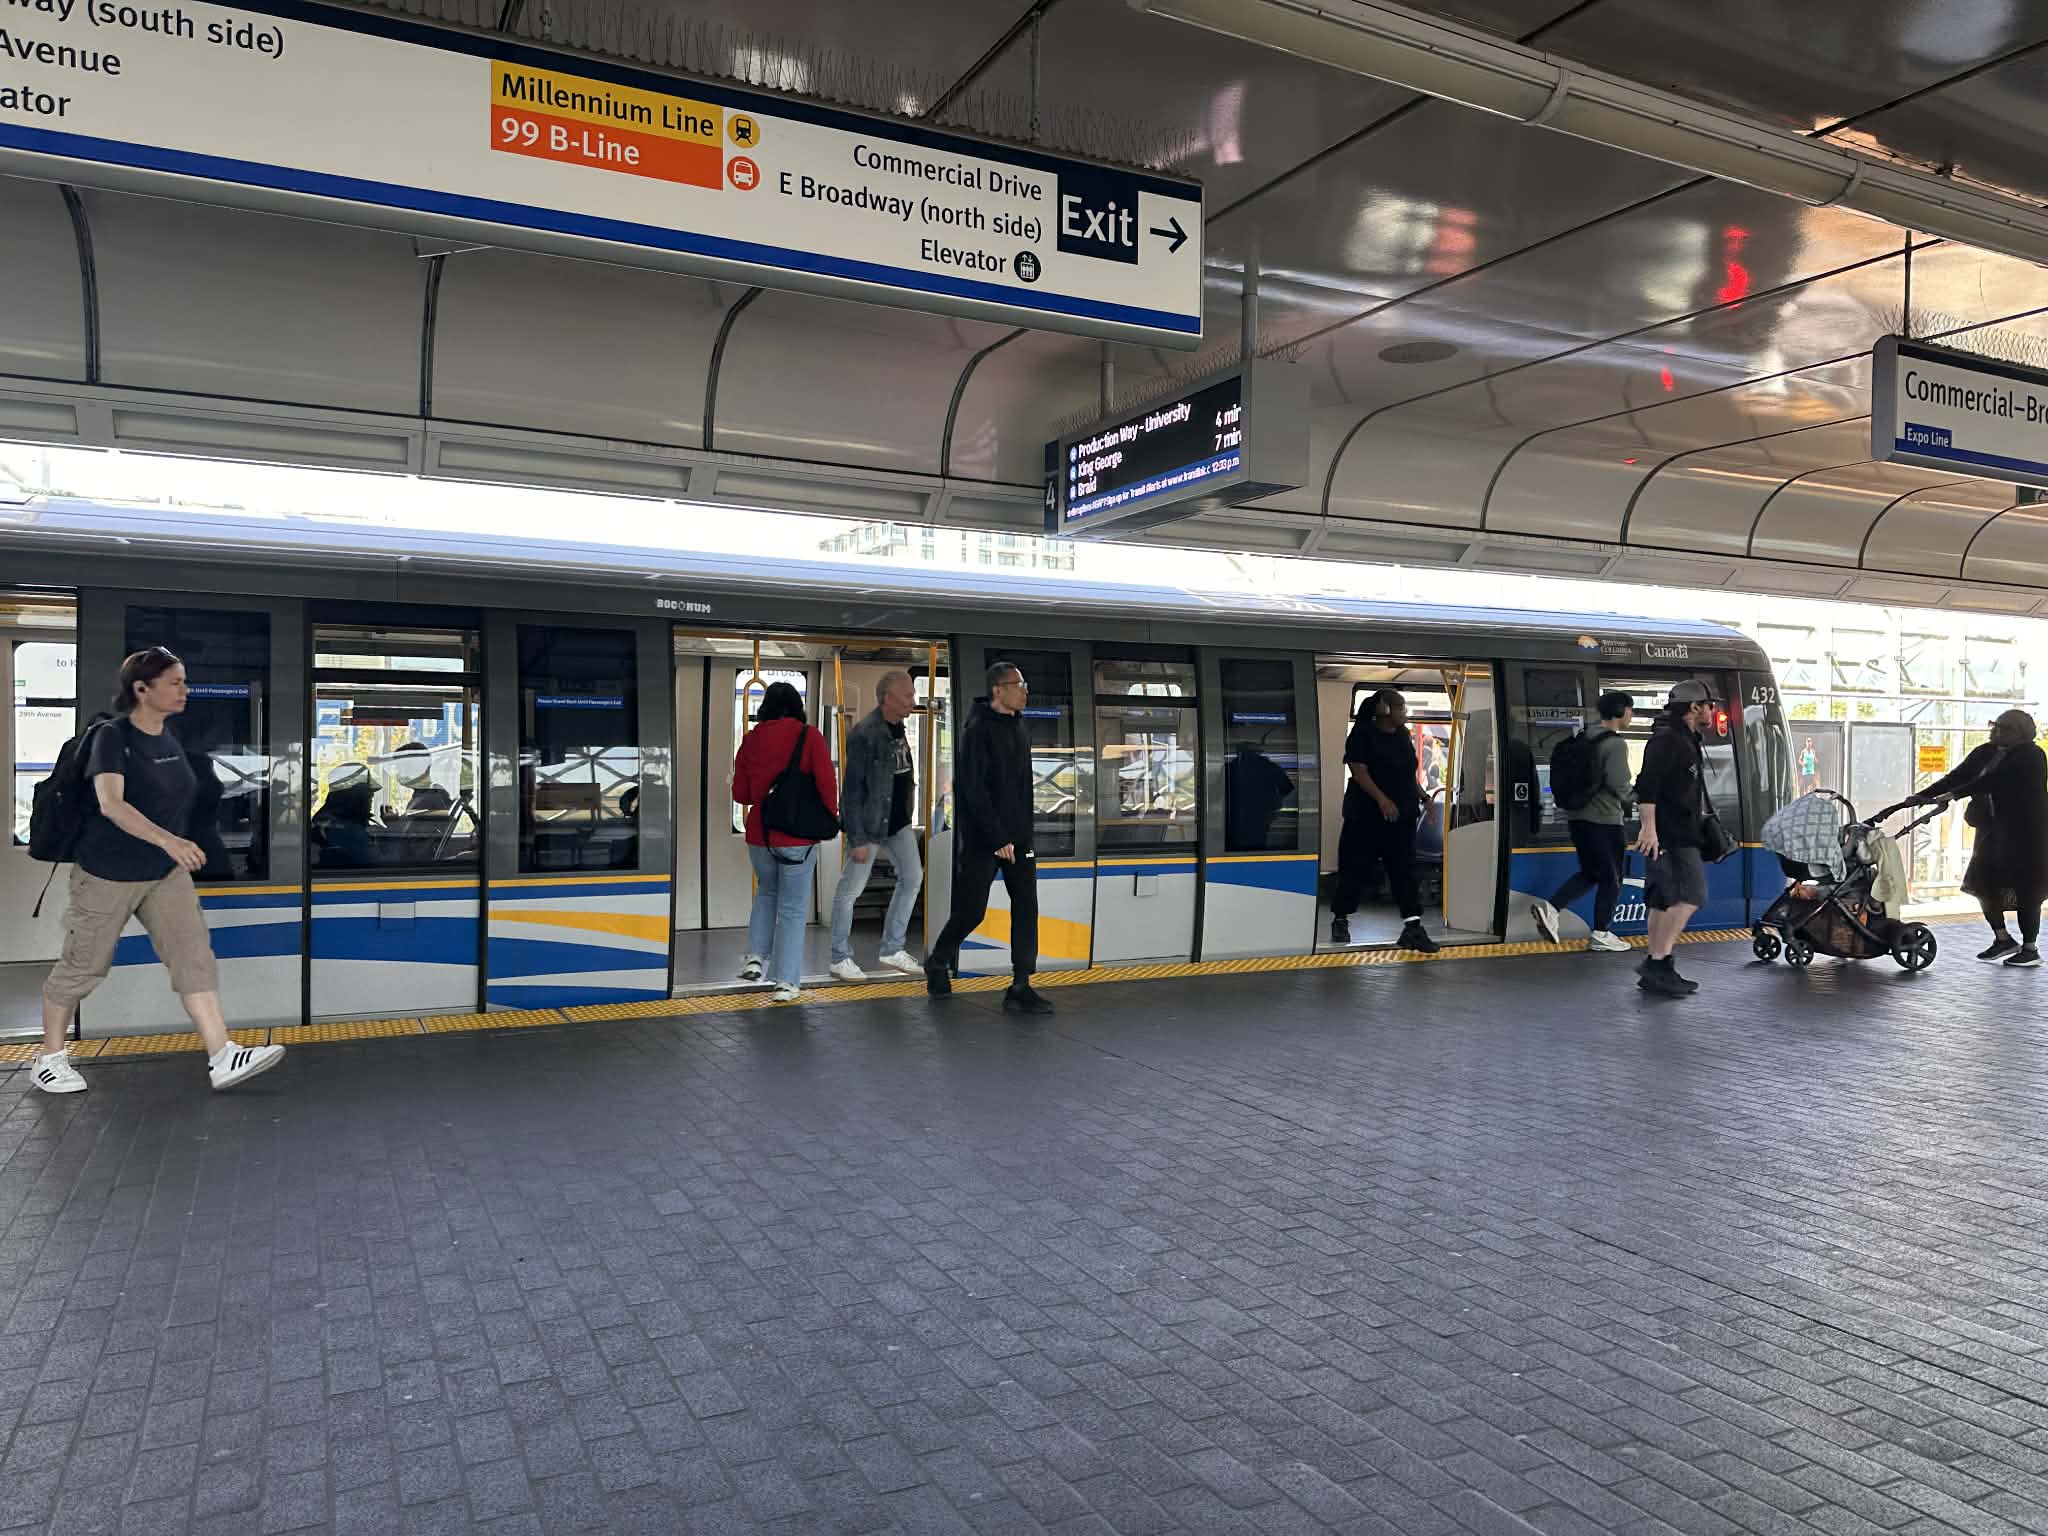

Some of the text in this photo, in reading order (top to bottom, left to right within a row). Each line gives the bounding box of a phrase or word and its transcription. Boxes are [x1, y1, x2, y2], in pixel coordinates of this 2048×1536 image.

[87, 0, 194, 39] (south
[207, 19, 285, 59] side)
[0, 28, 121, 75] Avenue
[0, 86, 71, 117] ator
[502, 73, 715, 137] Millennium Line
[501, 117, 640, 165] 99 B-Line
[853, 144, 1042, 201] Commercial Drive
[778, 172, 1042, 243] E Broadway (north side)
[1061, 194, 1134, 247] Exit
[921, 239, 1007, 275] Elevator
[1905, 371, 2048, 425] Commercial–Br
[1079, 432, 1119, 458] Production
[1120, 424, 1138, 442] Way
[1145, 403, 1191, 432] University
[1215, 411, 1222, 427] 4
[1215, 433, 1222, 451] 7
[1907, 428, 1949, 448] Expo Line
[1078, 451, 1122, 478] King George
[1046, 482, 1056, 510] 4
[1078, 476, 1097, 497] Braid
[1646, 642, 1688, 658] Canada
[1751, 686, 1775, 704] 432
[36, 711, 62, 719] Avenue
